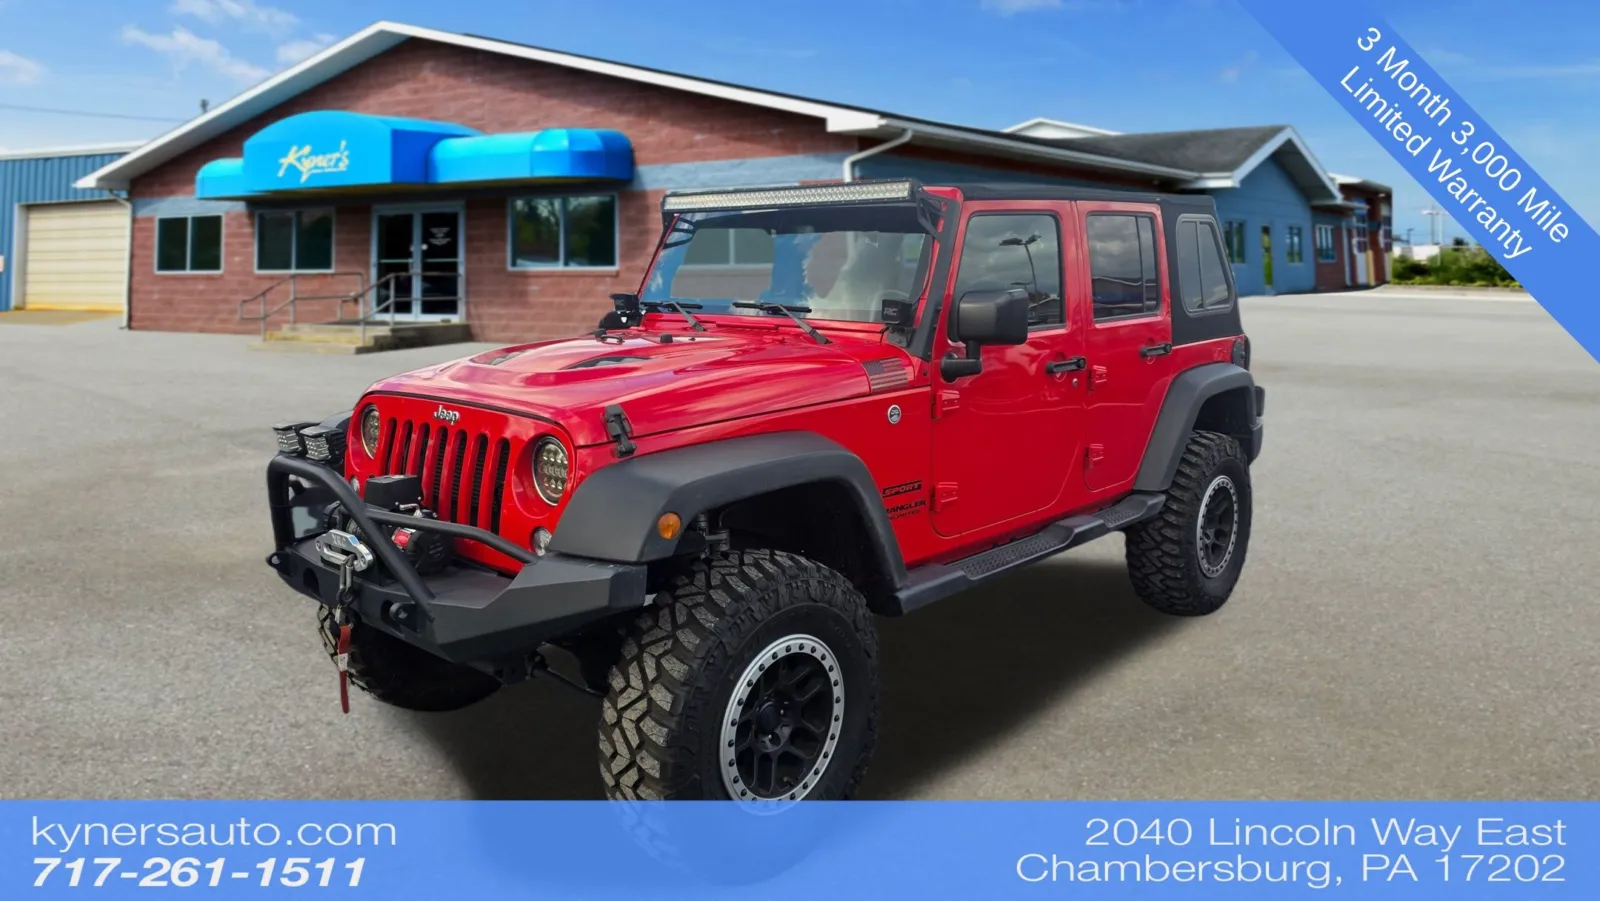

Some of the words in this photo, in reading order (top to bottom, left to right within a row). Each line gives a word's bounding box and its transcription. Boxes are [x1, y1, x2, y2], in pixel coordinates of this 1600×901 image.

[277, 140, 350, 184] Kyner's
[884, 307, 898, 316] RC
[433, 404, 460, 425] Jeep
[883, 481, 922, 497] SPORT
[331, 533, 347, 548] XRC
